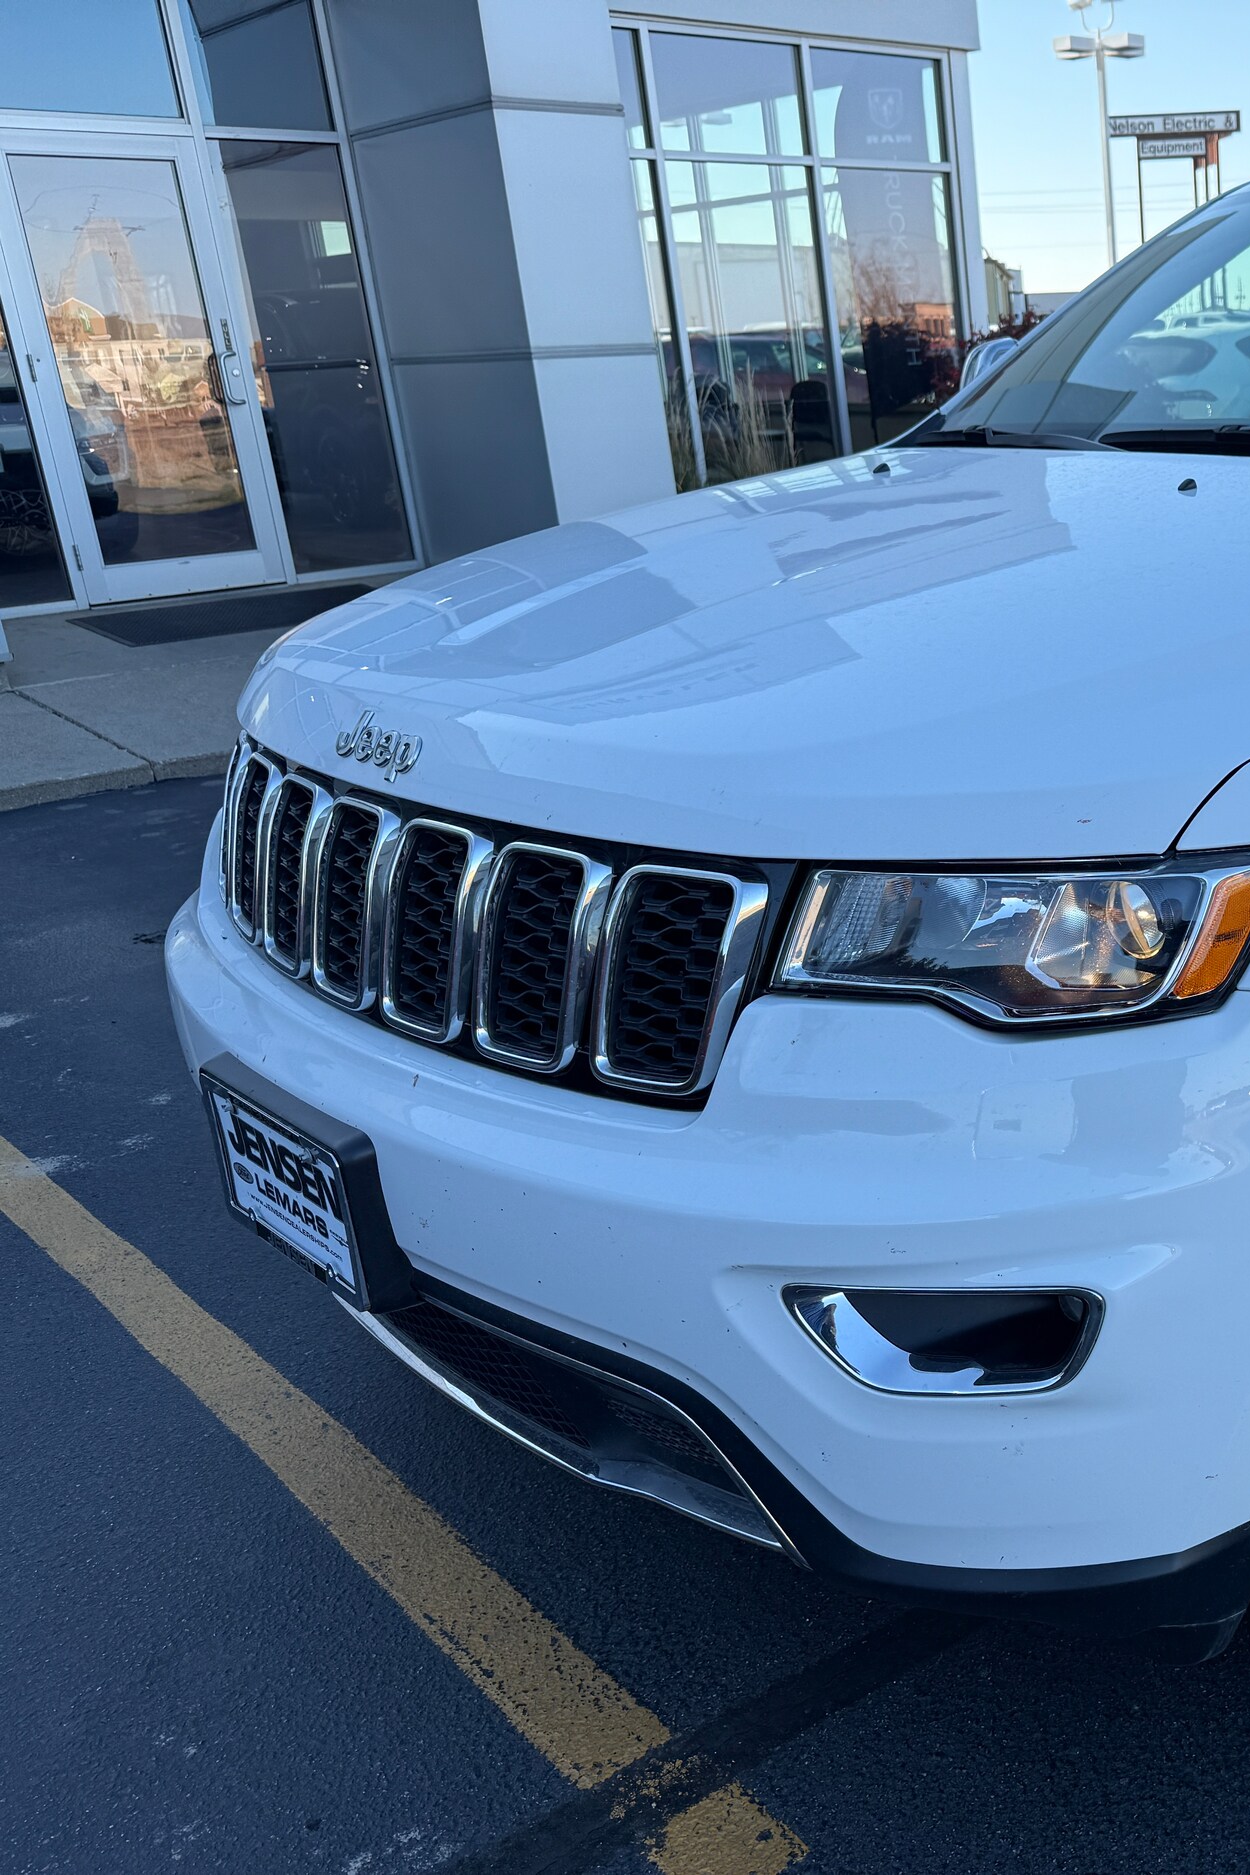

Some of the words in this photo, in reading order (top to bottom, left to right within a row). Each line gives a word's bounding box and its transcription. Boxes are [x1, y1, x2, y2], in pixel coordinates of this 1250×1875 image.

[866, 134, 913, 144] RAM
[1109, 118, 1155, 133] Nelson
[1163, 115, 1216, 131] Electric
[1224, 113, 1234, 128] &
[1141, 140, 1204, 155] Equipment
[884, 155, 909, 251] RUCK
[335, 710, 423, 783] Jeep
[228, 1114, 344, 1223] JENSEN
[254, 1172, 329, 1239] LEMARS
[267, 1232, 316, 1276] JENSEN
